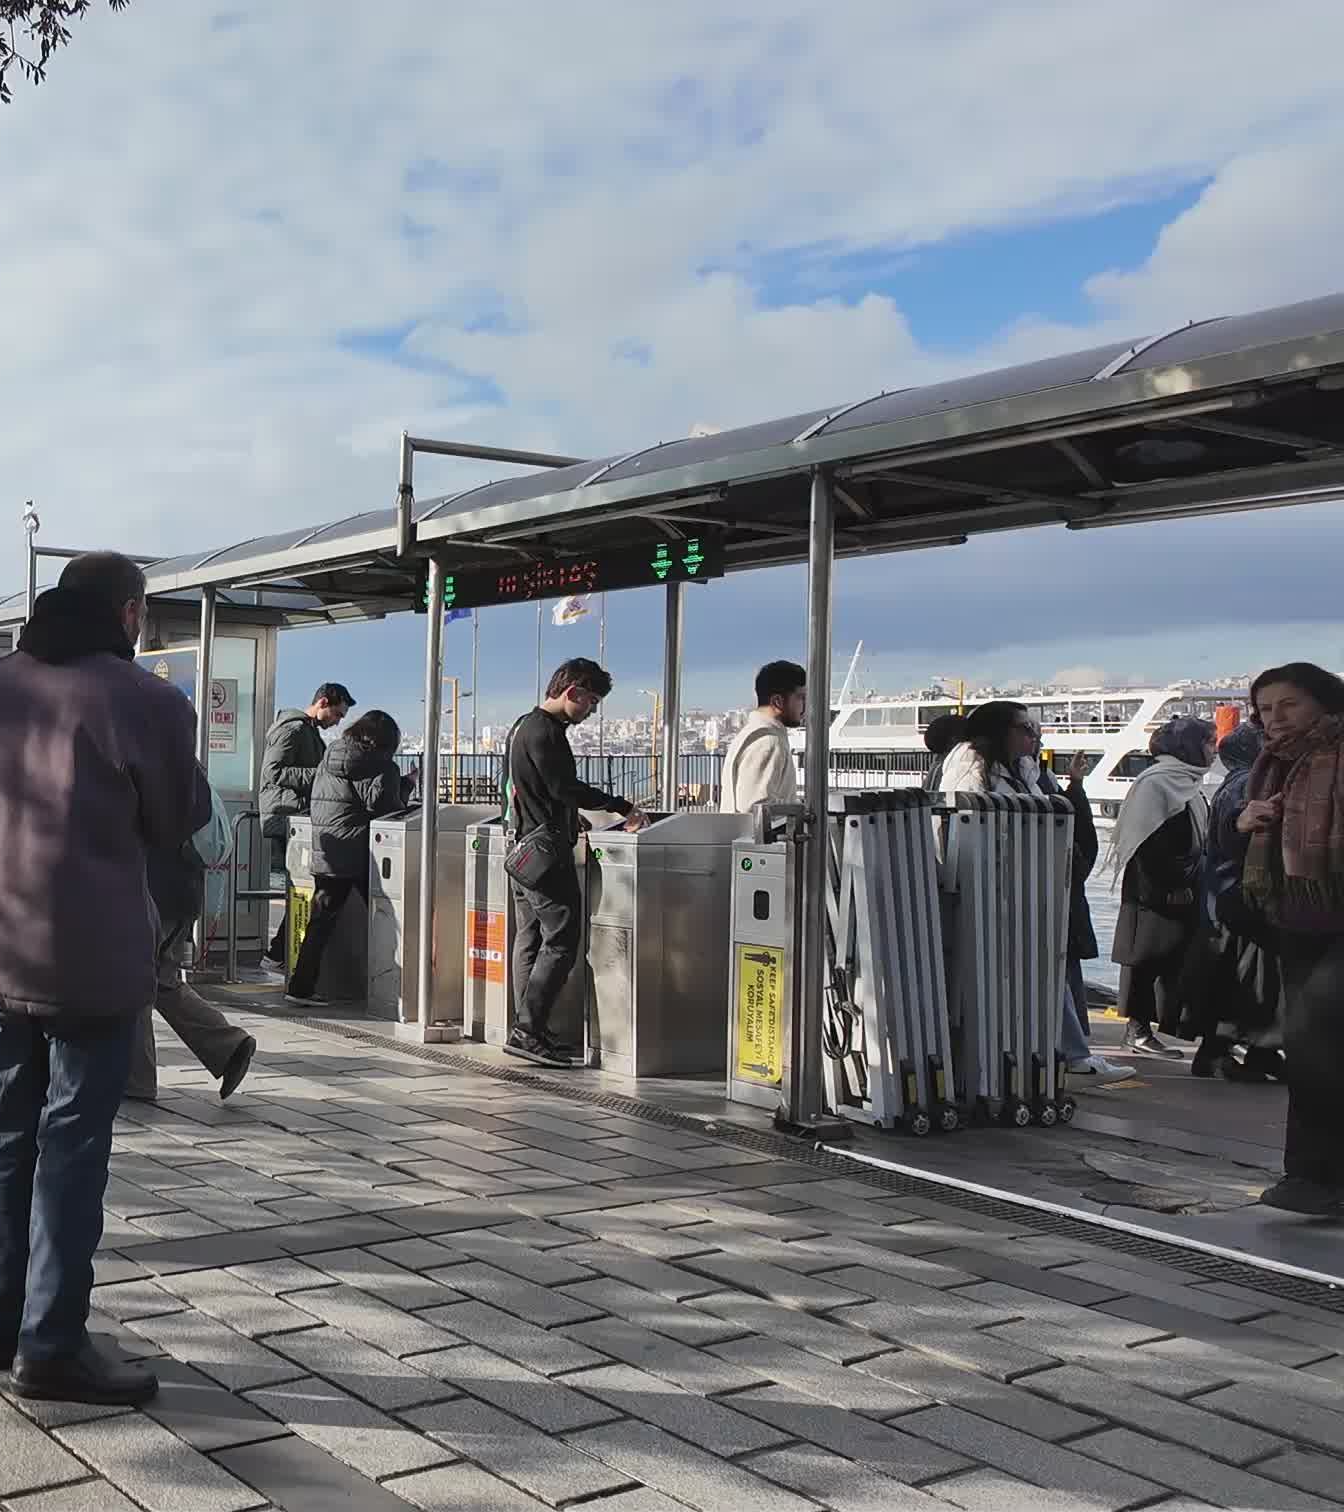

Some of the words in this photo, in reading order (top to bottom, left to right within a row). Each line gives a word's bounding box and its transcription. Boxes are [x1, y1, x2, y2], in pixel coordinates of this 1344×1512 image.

[756, 969, 765, 1006] SOSYAL
[768, 992, 776, 1018] SAFE
[746, 984, 755, 1042] KORUYALIM
[767, 1018, 775, 1065] DISTANCE
